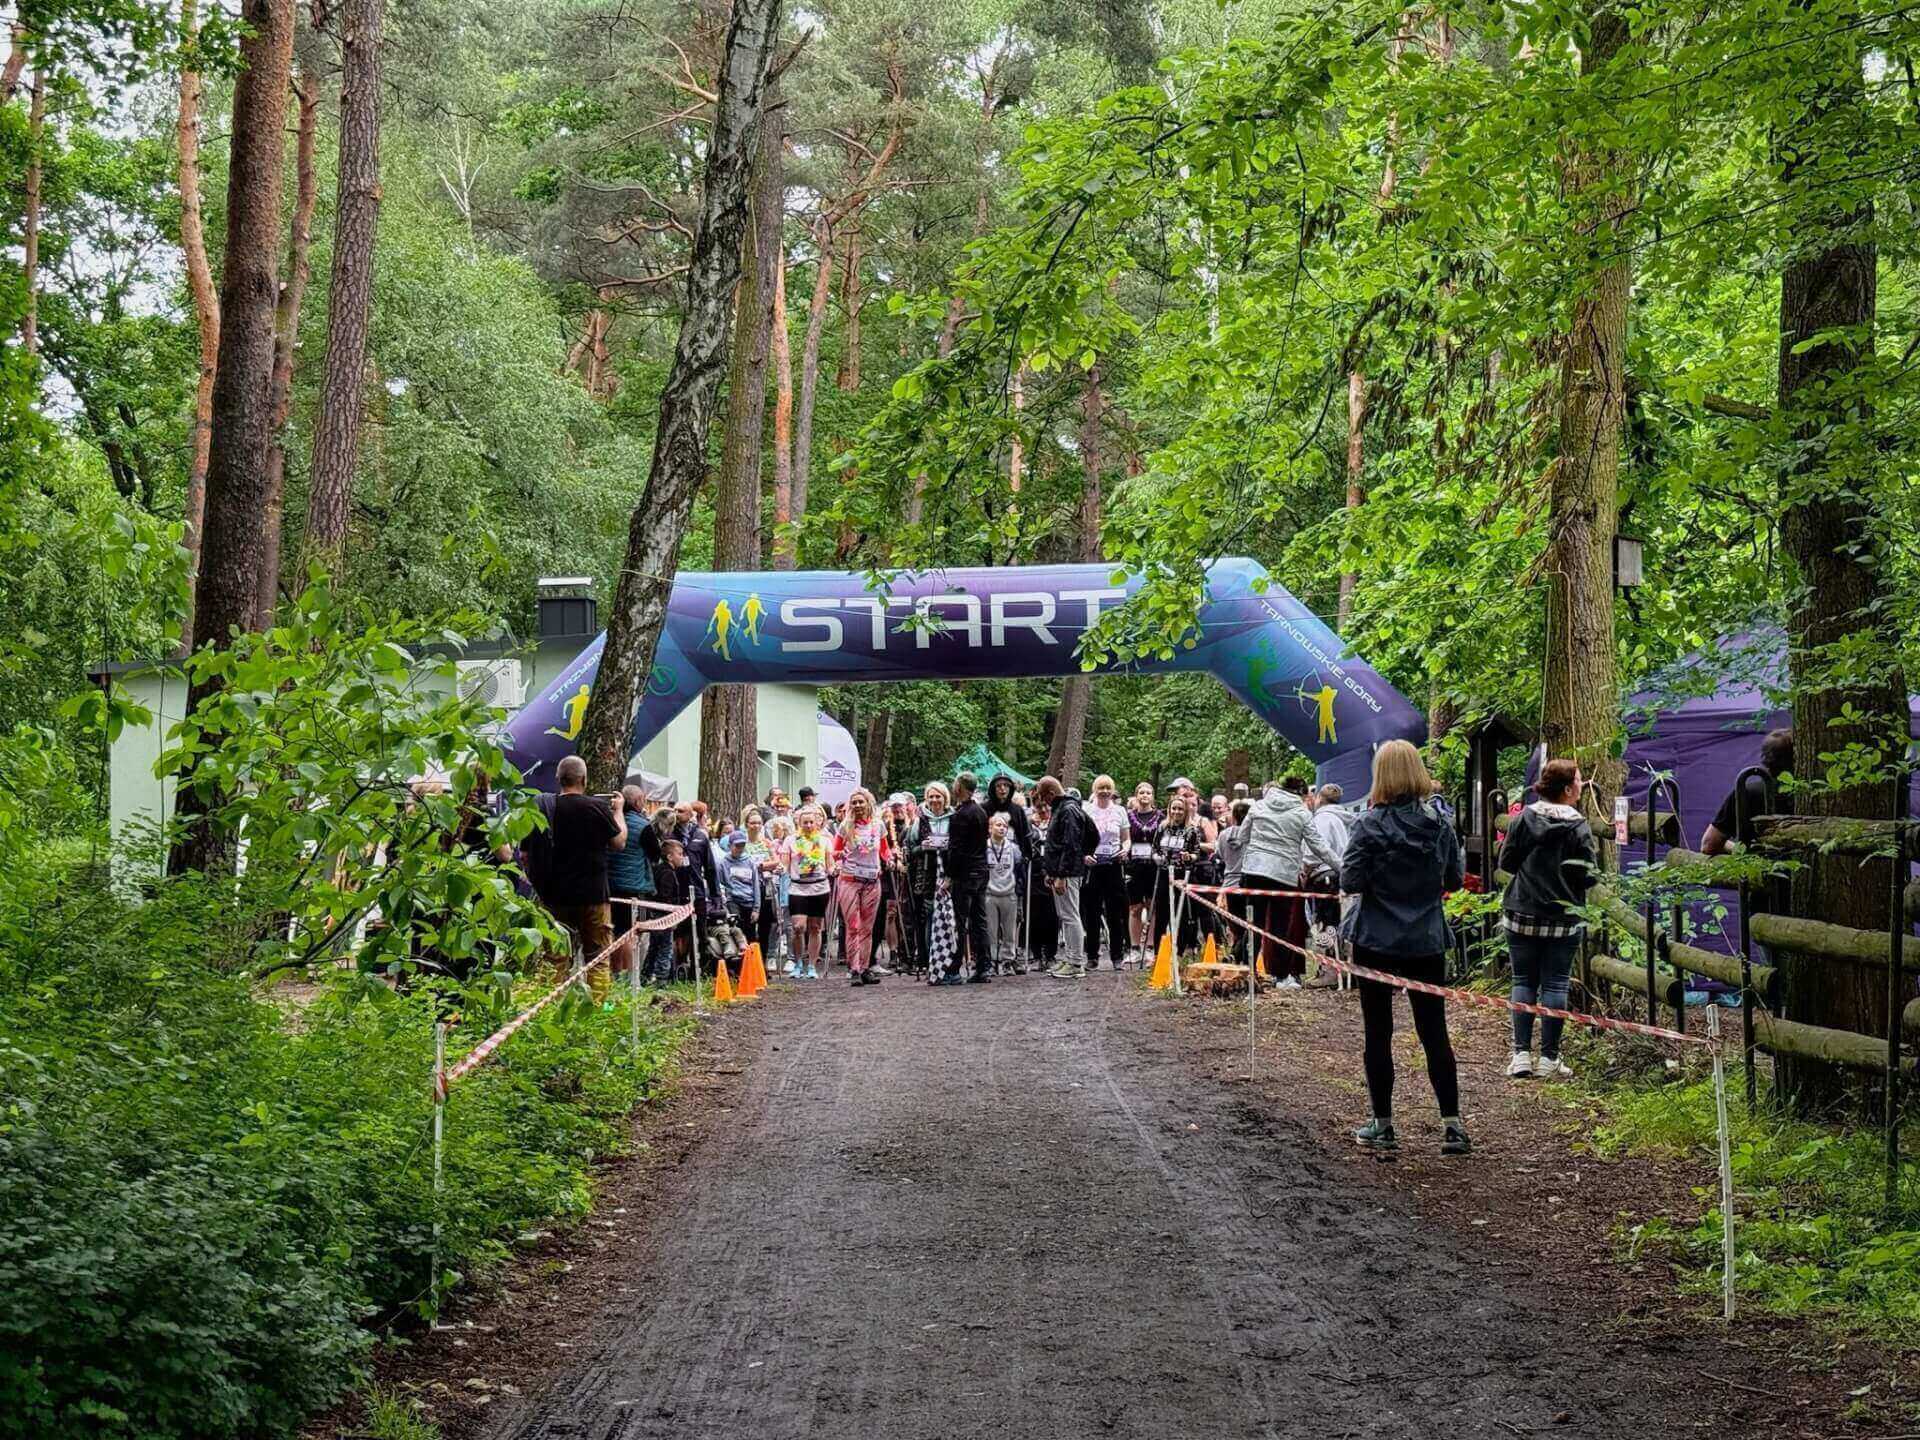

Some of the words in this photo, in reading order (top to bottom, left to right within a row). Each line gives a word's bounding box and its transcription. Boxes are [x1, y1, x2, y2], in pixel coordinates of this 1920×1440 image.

[780, 588, 1127, 652] START
[1260, 600, 1345, 680] TARNOWSKIE
[1343, 676, 1382, 712] GÓRY
